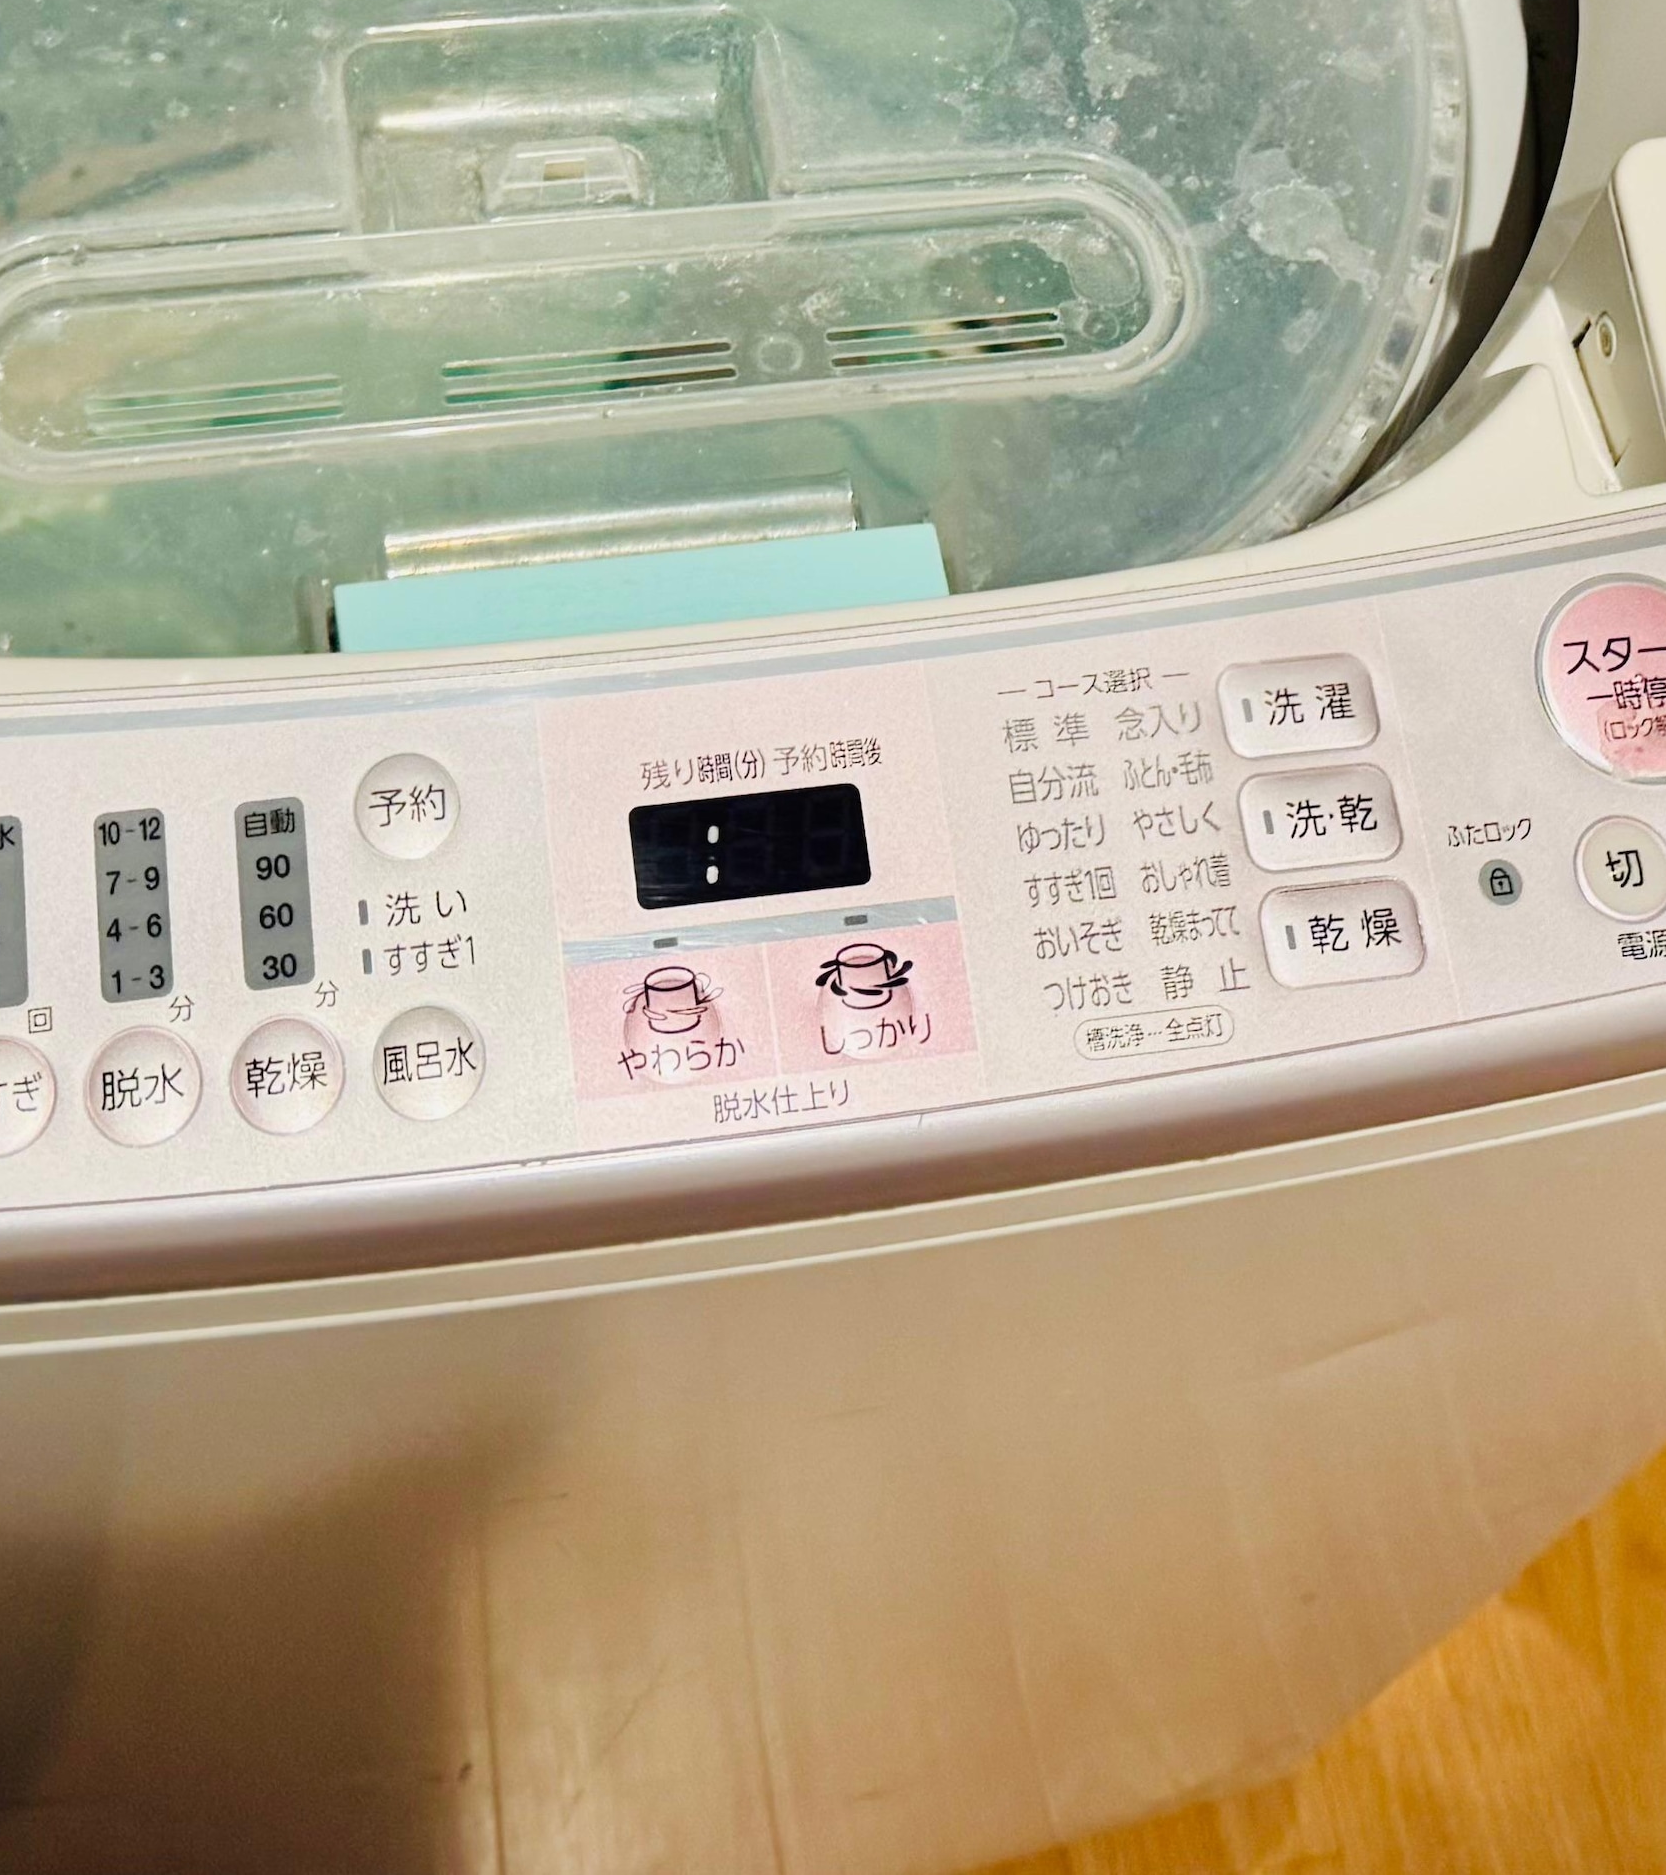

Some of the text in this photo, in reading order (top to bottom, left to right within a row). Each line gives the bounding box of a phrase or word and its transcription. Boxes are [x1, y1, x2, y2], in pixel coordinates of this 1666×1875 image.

[1033, 667, 1153, 699] コース選択
[1114, 700, 1202, 742] 念入り
[1264, 682, 1356, 726] 洗濯
[1002, 712, 1090, 754] 標準
[1008, 762, 1100, 805] 自分流
[1123, 750, 1214, 791] ふとん・毛布
[245, 807, 296, 839] 自動
[368, 783, 446, 828] 予約
[1132, 800, 1221, 841] やさしく
[98, 816, 162, 846] 10-12
[1017, 813, 1106, 854] ゆったり
[1447, 818, 1532, 848] ふたロック
[106, 866, 161, 895] 7-9
[255, 854, 291, 881] 90
[1024, 866, 1117, 908] すすぎ1回
[1140, 852, 1231, 894] おしゃれ着
[1605, 849, 1644, 888] 切
[107, 913, 162, 942] 4-6
[259, 903, 294, 929] 60
[385, 890, 468, 927] 洗い
[1148, 905, 1241, 946] 乾燥まってて
[1033, 915, 1123, 960] おいそぎ
[1308, 908, 1402, 954] 乾燥
[262, 953, 297, 981] 30
[383, 935, 476, 976] すすぎ1
[112, 965, 165, 994] 1-3
[314, 980, 339, 1009] 分
[1043, 970, 1133, 1011] つけおき
[1159, 957, 1251, 1001] 静止
[28, 1006, 53, 1034] 回
[169, 994, 195, 1023] 分
[820, 1012, 932, 1056] しっかり
[245, 1050, 328, 1098] 乾燥
[383, 1036, 477, 1085] 風呂水
[617, 1036, 745, 1080] やわらか
[101, 1063, 185, 1111] 脱水
[713, 1078, 849, 1124] 脱水仕上り
